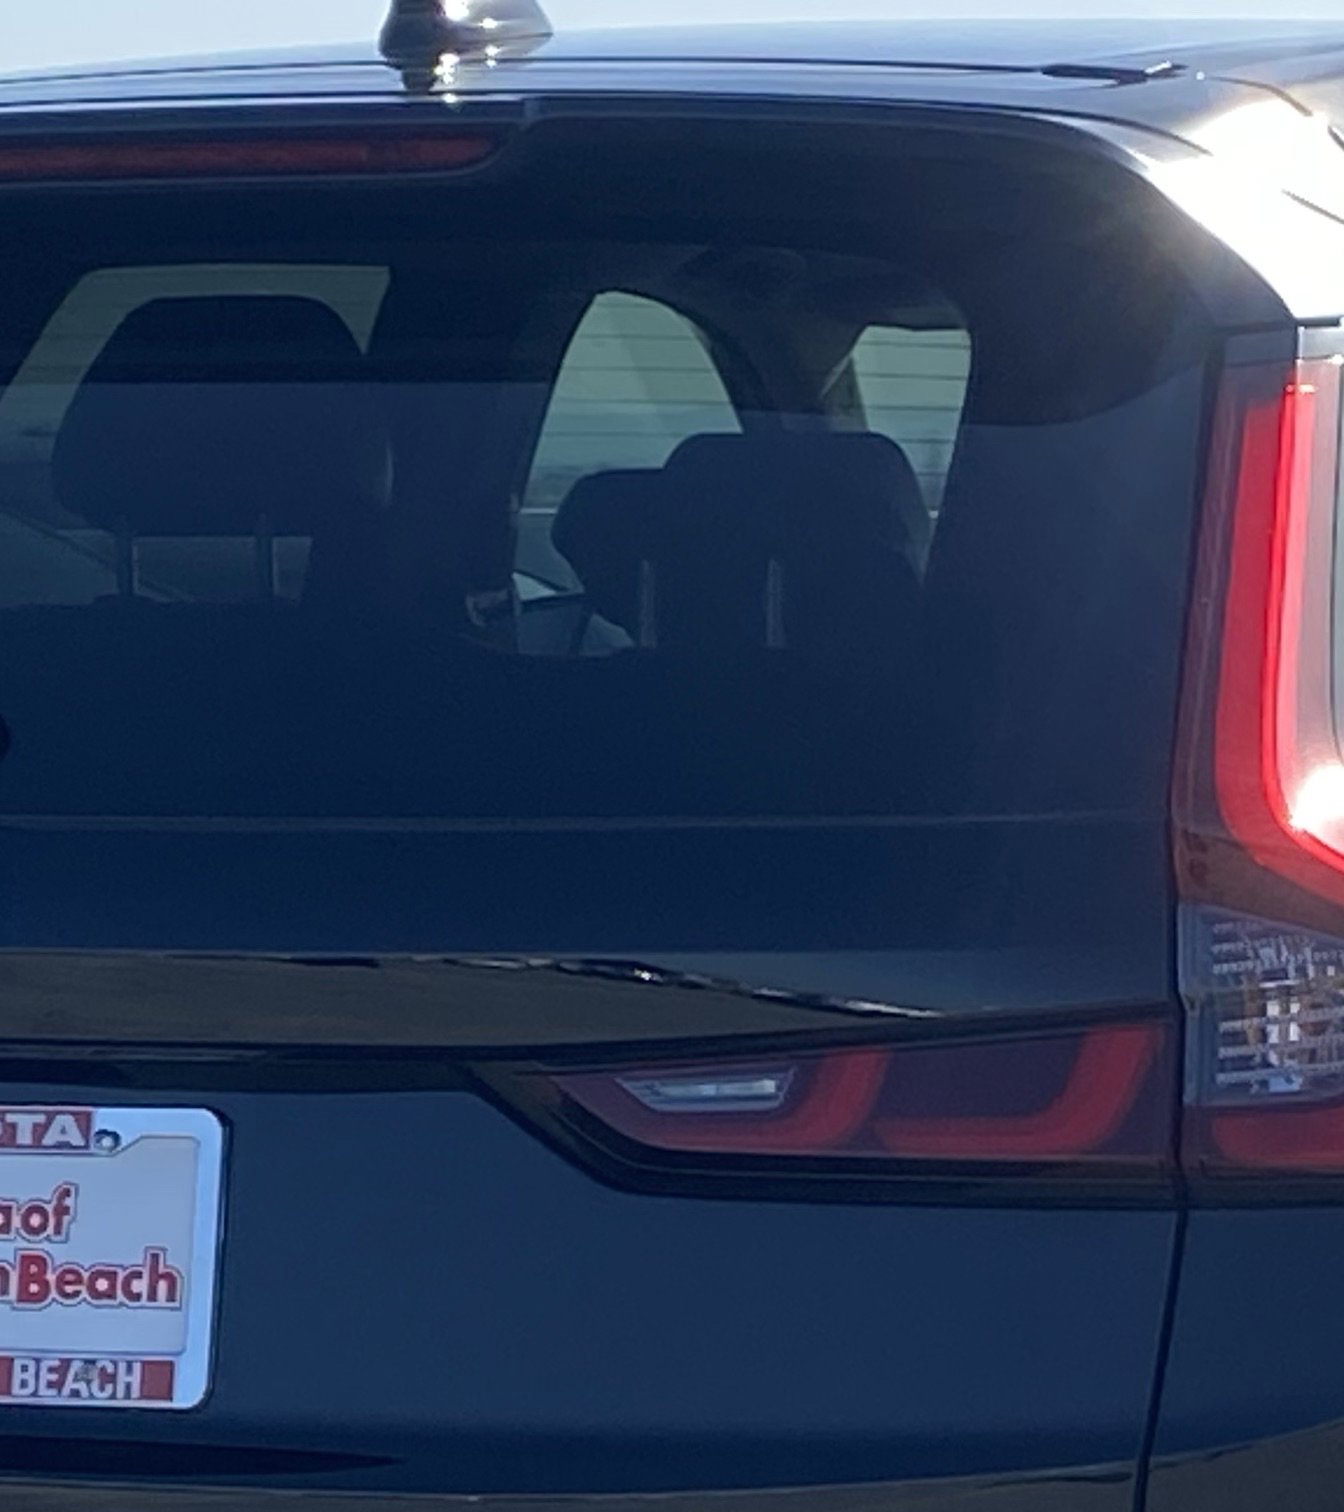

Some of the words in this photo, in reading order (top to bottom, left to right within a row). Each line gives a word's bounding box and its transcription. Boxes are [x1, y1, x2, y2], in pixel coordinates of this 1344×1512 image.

[20, 1185, 72, 1238] of
[15, 1252, 178, 1304] Beach
[11, 1357, 142, 1399] BEACH
